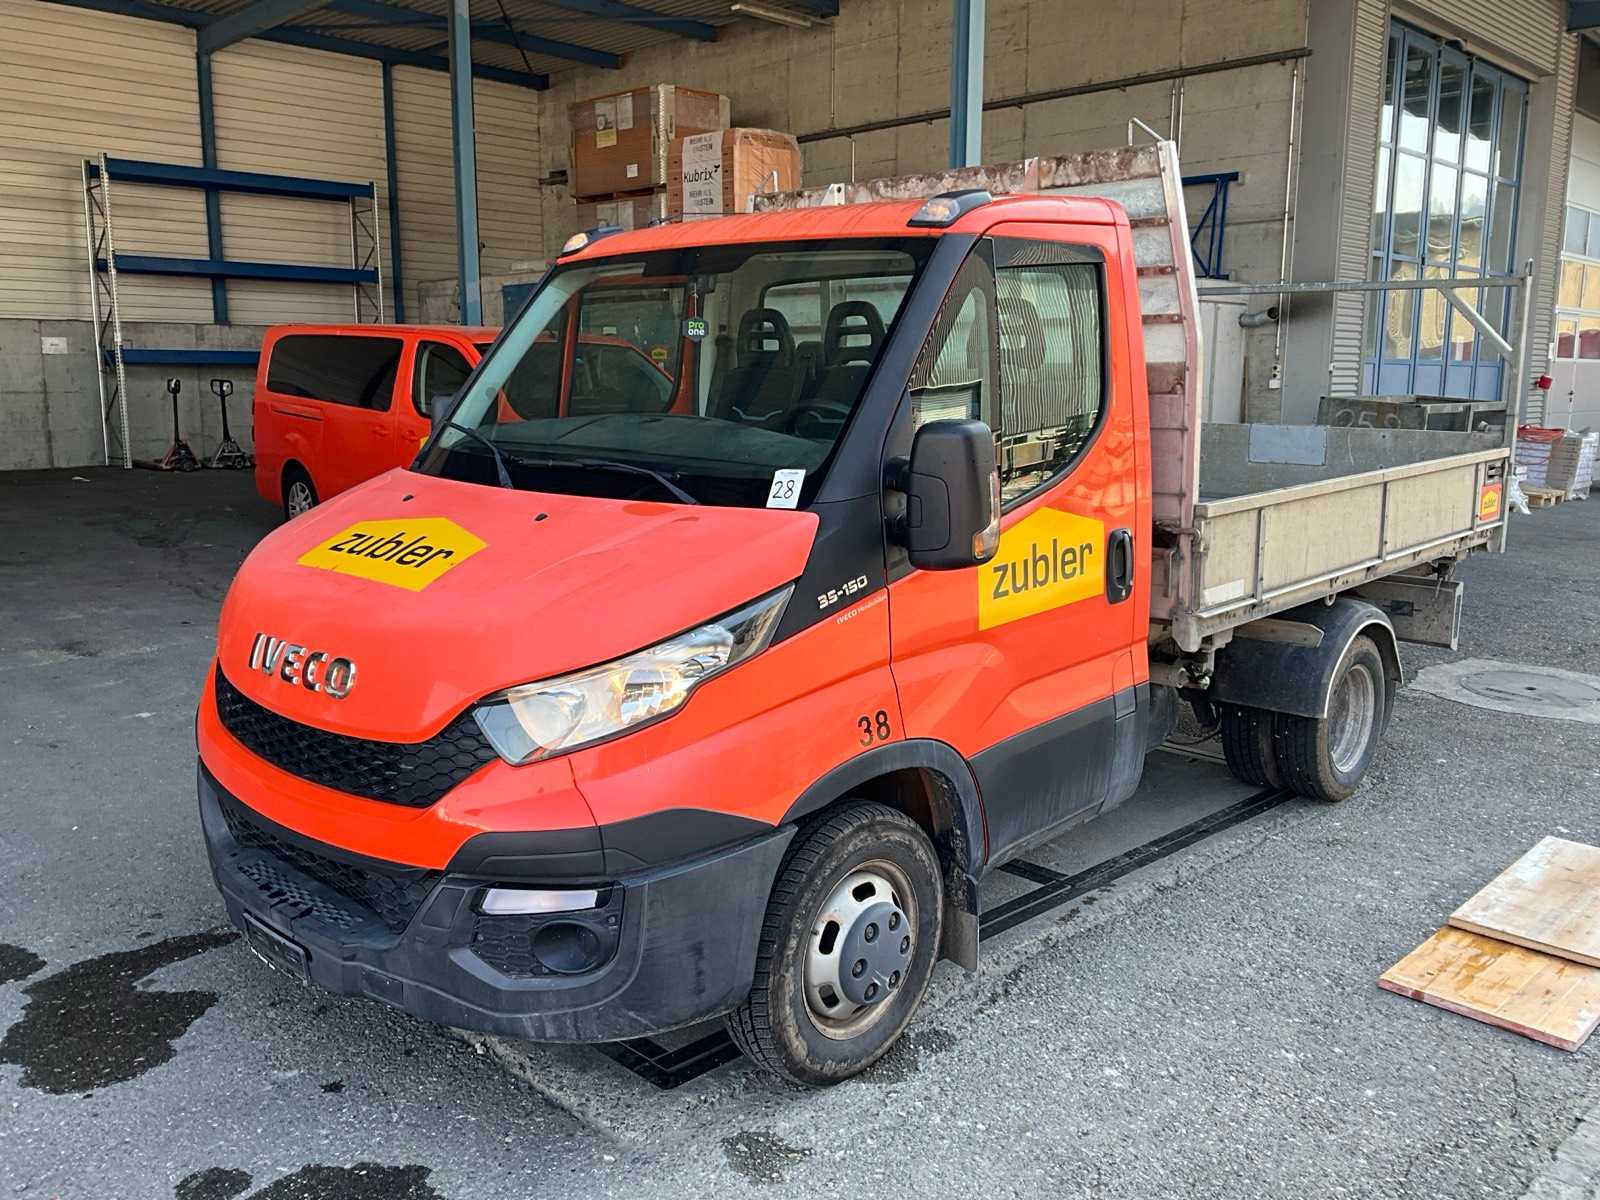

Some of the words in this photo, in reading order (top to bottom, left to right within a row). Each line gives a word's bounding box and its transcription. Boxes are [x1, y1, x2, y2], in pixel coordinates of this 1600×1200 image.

[683, 168, 713, 183] Kubrix
[772, 479, 796, 500] 28
[328, 532, 454, 568] zubler
[993, 537, 1093, 600] zubler
[817, 575, 868, 609] 35-150
[836, 609, 858, 624] IVECO
[248, 633, 356, 699] IVECO
[857, 710, 891, 747] 38
